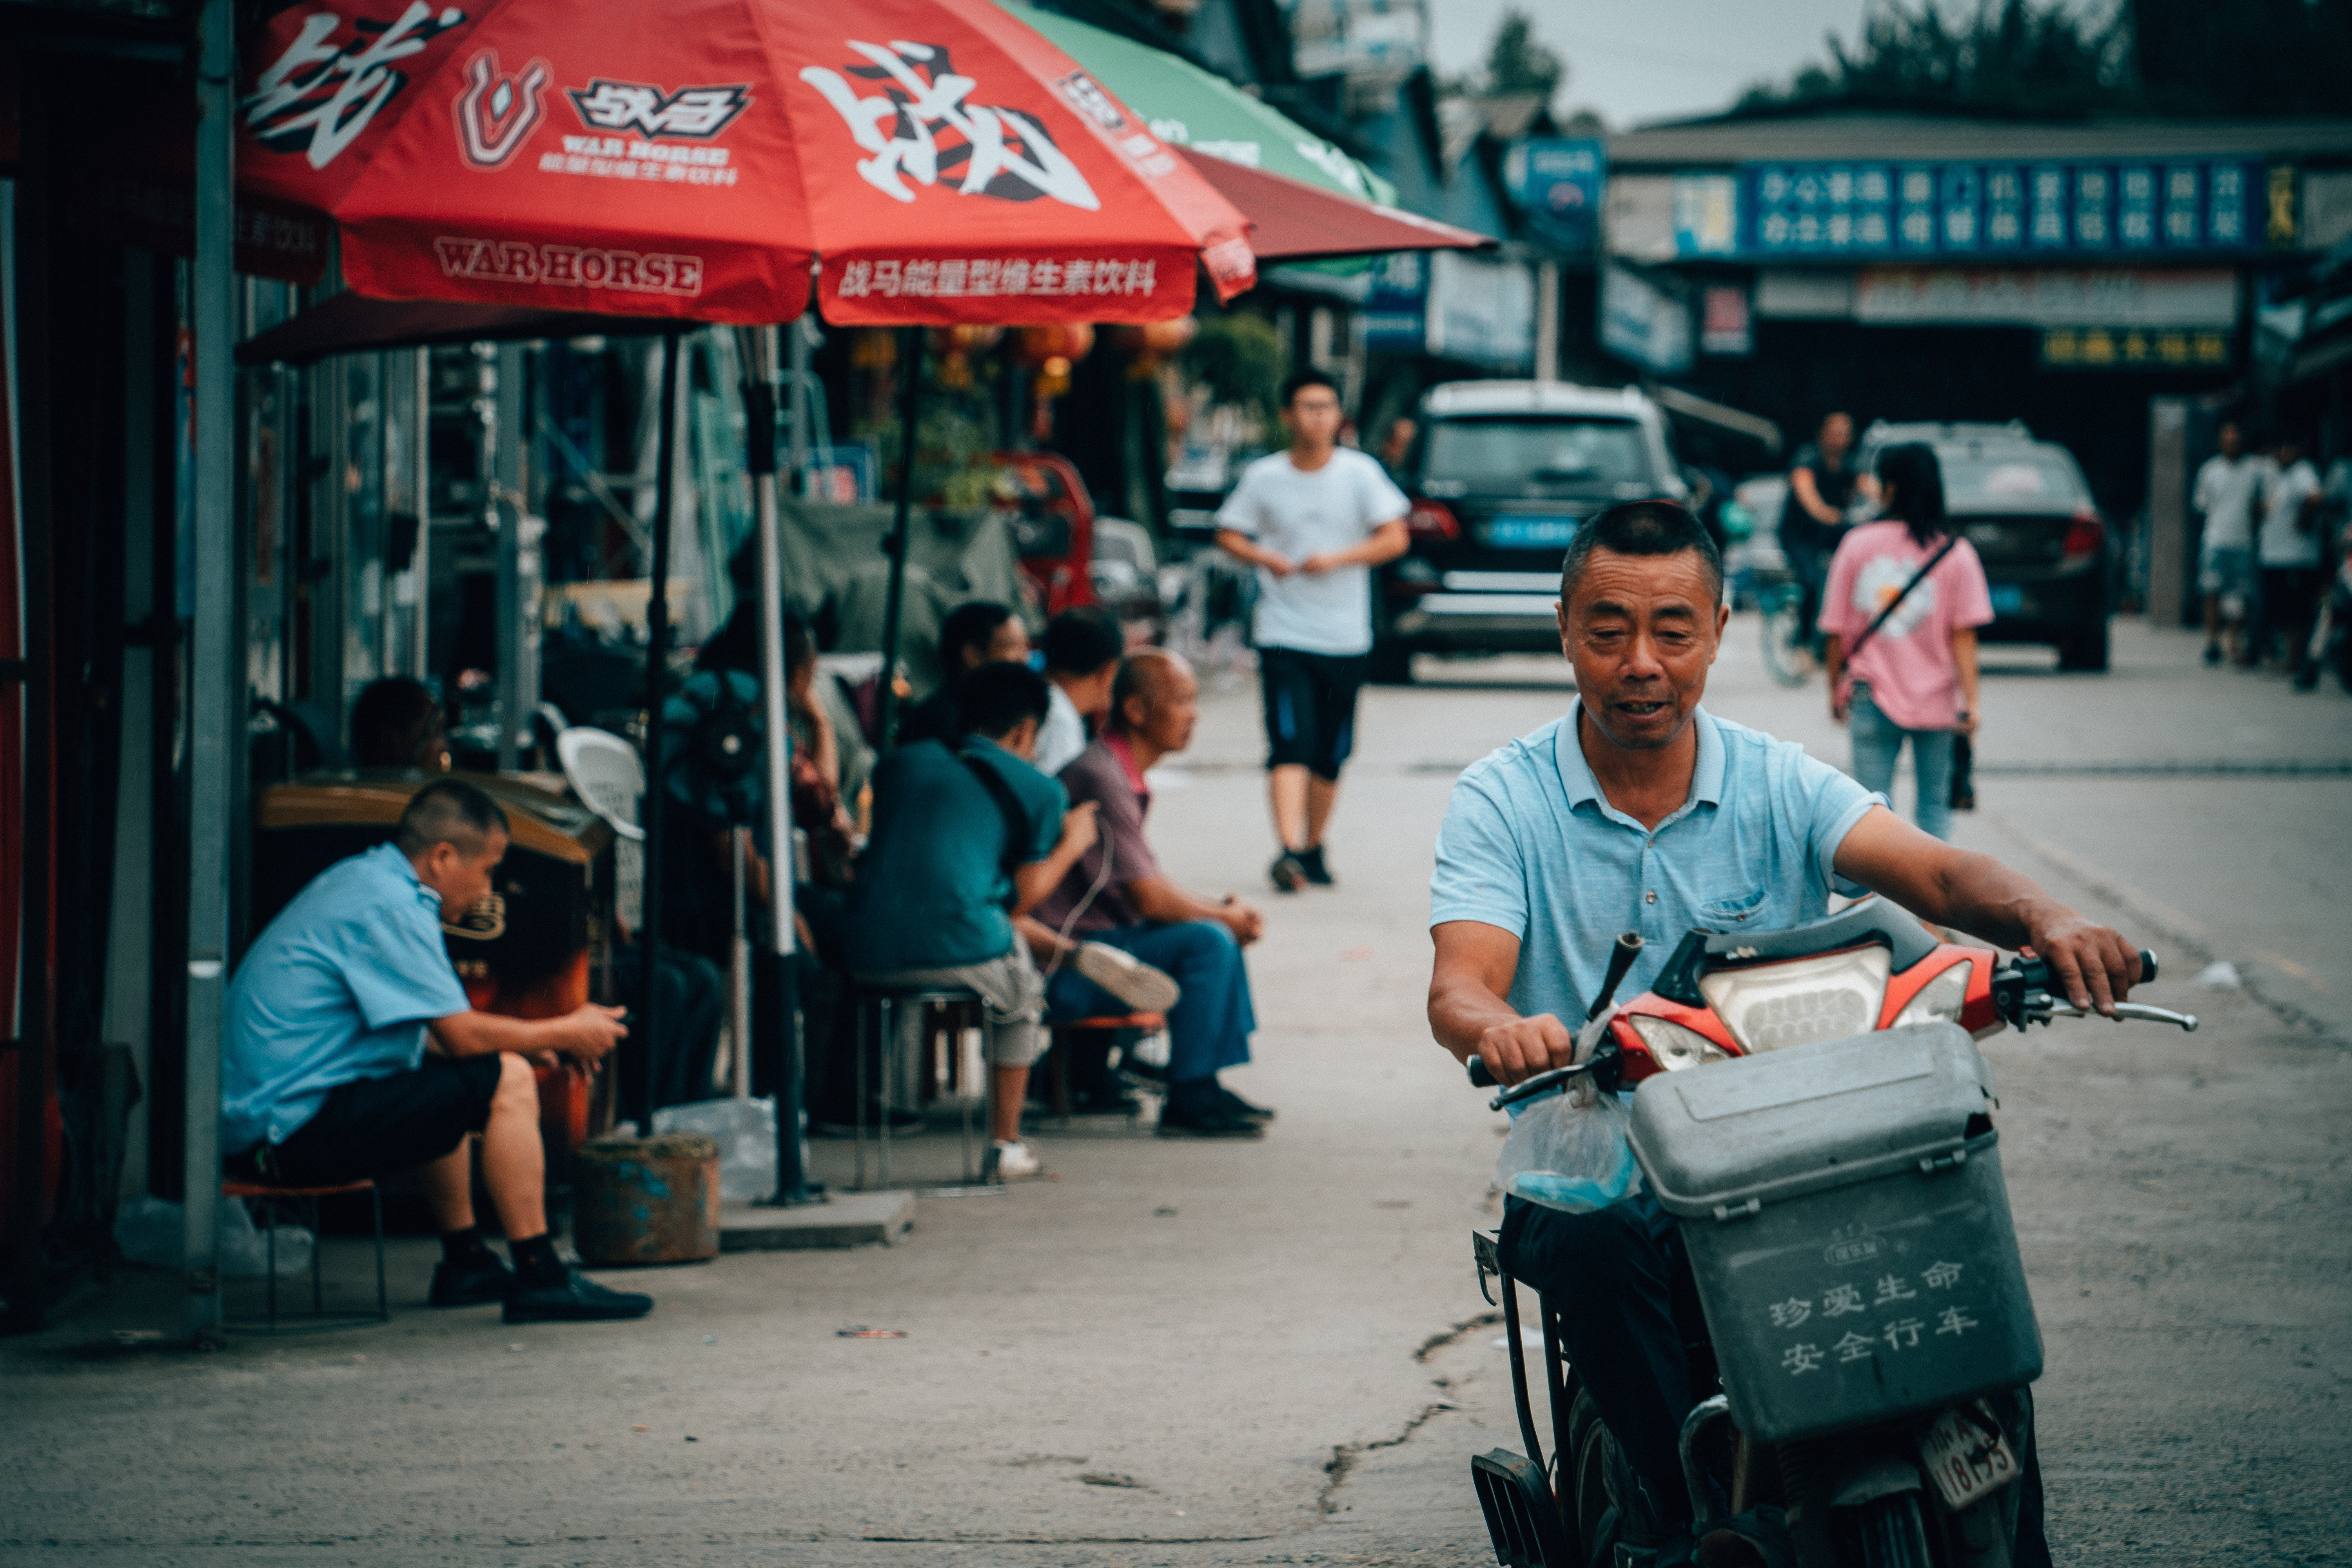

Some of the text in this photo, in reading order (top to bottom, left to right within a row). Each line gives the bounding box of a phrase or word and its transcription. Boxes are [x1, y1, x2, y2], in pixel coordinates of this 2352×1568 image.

[562, 134, 730, 166] WAR HORSE
[838, 258, 1157, 298] 战马能量型维生素饮料
[1769, 1260, 1964, 1330] 珍爱生命
[1781, 1305, 1979, 1376] 安全行车
